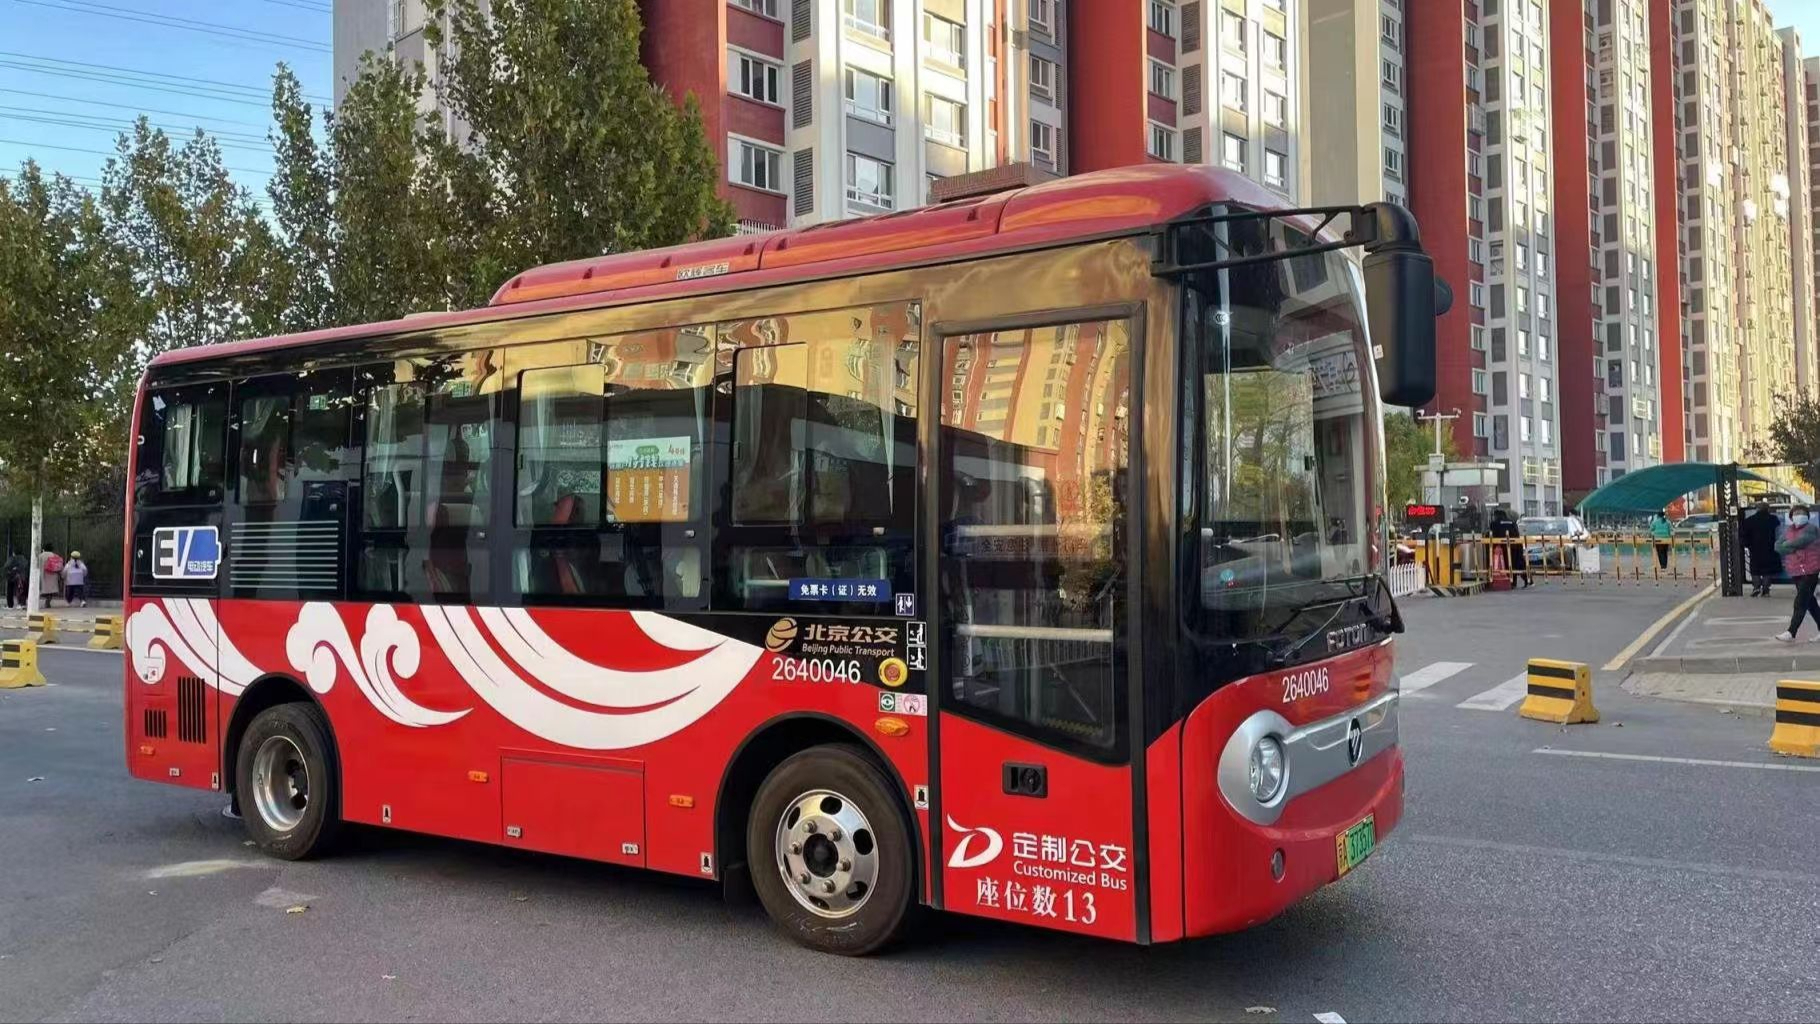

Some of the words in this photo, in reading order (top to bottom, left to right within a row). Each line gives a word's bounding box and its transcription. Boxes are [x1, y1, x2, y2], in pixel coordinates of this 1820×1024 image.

[155, 529, 194, 577] EV
[803, 623, 898, 644] 北京公交
[802, 643, 828, 655] Beijing
[829, 645, 853, 655] Public
[855, 646, 895, 658] Transport
[772, 657, 861, 684] 2640046
[1282, 667, 1329, 704] 2640046
[1013, 832, 1127, 872] 定制公交
[1013, 861, 1096, 886] Customized
[1101, 873, 1127, 891] Bus
